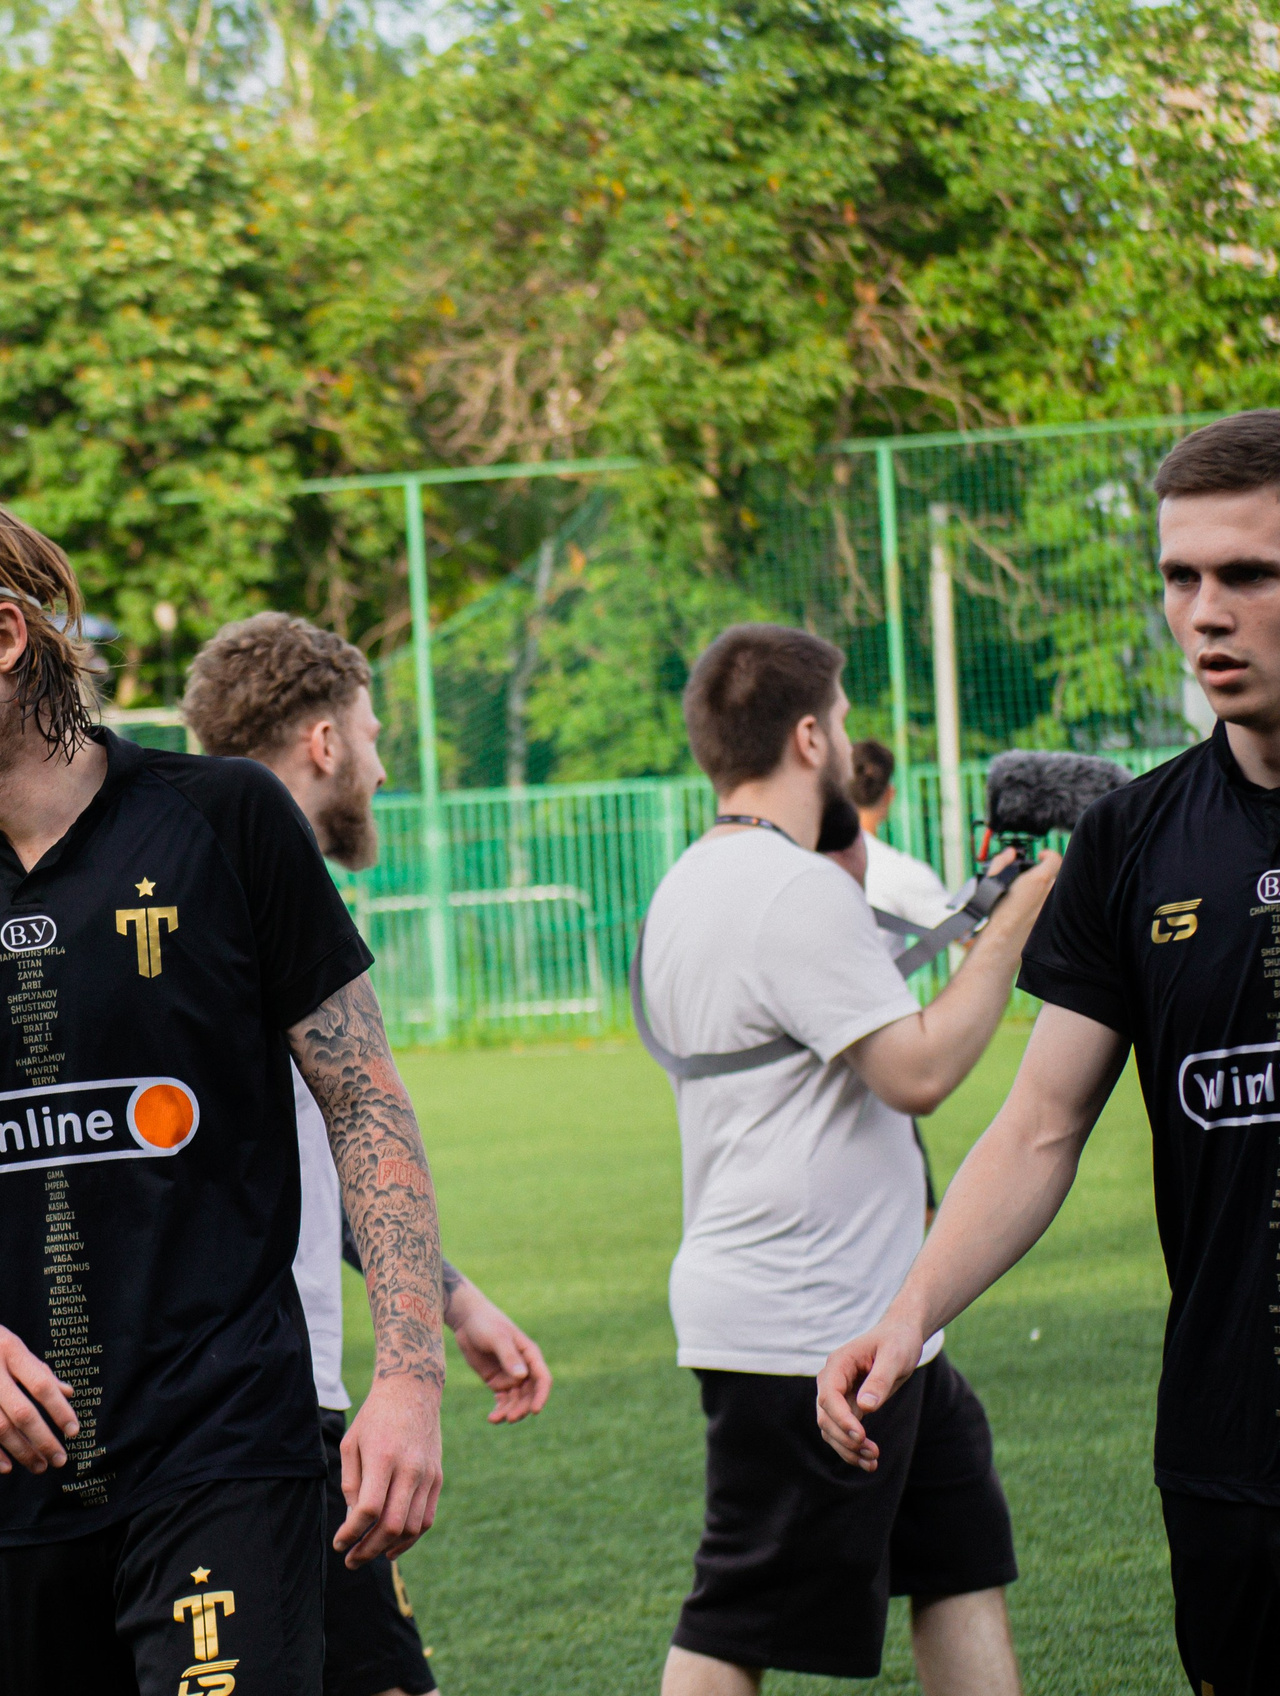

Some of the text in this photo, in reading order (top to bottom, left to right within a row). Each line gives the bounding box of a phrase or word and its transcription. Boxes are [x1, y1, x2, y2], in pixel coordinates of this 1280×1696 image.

[17, 959, 42, 970] TITAN
[17, 969, 44, 981] ZAYKA
[21, 980, 41, 991] ARBI
[7, 989, 58, 1004] SHEPLYAKOV
[10, 1000, 57, 1014] SHUSTIKOV
[11, 1011, 58, 1025] LUSHNIKOV
[23, 1023, 43, 1033] BRAT
[23, 1033, 43, 1044] BRAT
[29, 1044, 49, 1054] PISK
[15, 1052, 66, 1067] KHARLAMOV
[25, 1064, 59, 1076] MAVRIN
[32, 1075, 57, 1086] BIRYA
[46, 1231, 80, 1243] RAHMANI
[44, 1242, 85, 1255] DVORNIKOV
[53, 1253, 73, 1263] VAGA
[43, 1262, 90, 1275] HYPERTONUS
[56, 1274, 73, 1284] BOB
[50, 1284, 82, 1295] KISELEV
[48, 1294, 87, 1306] ALUMONA
[52, 1305, 83, 1316] KASHAI
[49, 1315, 89, 1327] TAVUZIAN
[50, 1326, 89, 1337] OLD MAN
[59, 1336, 88, 1347] COACH
[44, 1345, 103, 1359] SHAMAZVANEC
[55, 1356, 91, 1369] GAV-GAV
